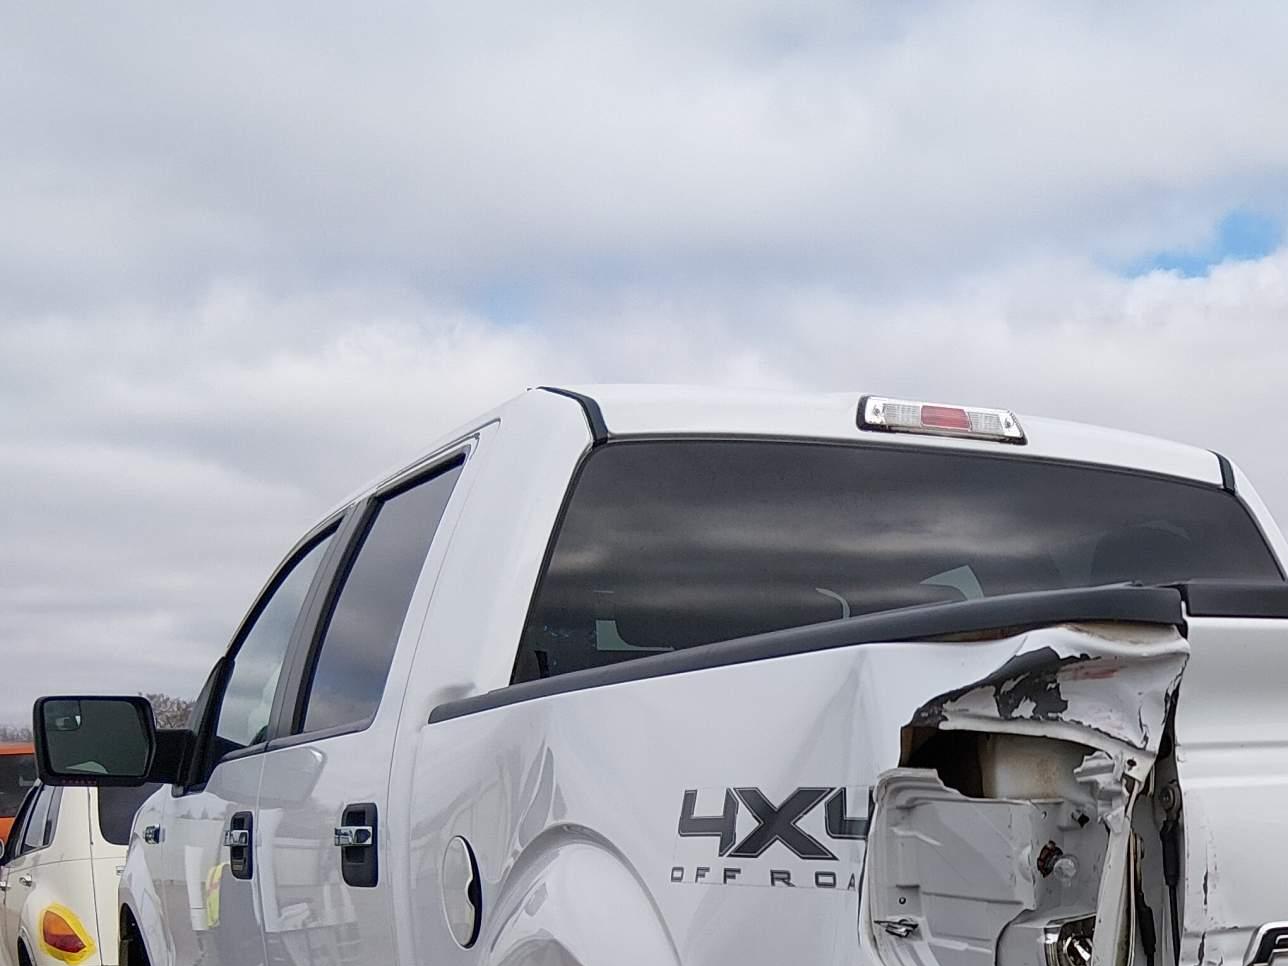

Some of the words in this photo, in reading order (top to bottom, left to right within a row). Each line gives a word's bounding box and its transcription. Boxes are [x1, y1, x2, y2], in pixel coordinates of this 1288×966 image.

[678, 786, 876, 860] 4X4
[670, 866, 742, 884] OFF
[769, 868, 857, 891] ROA
